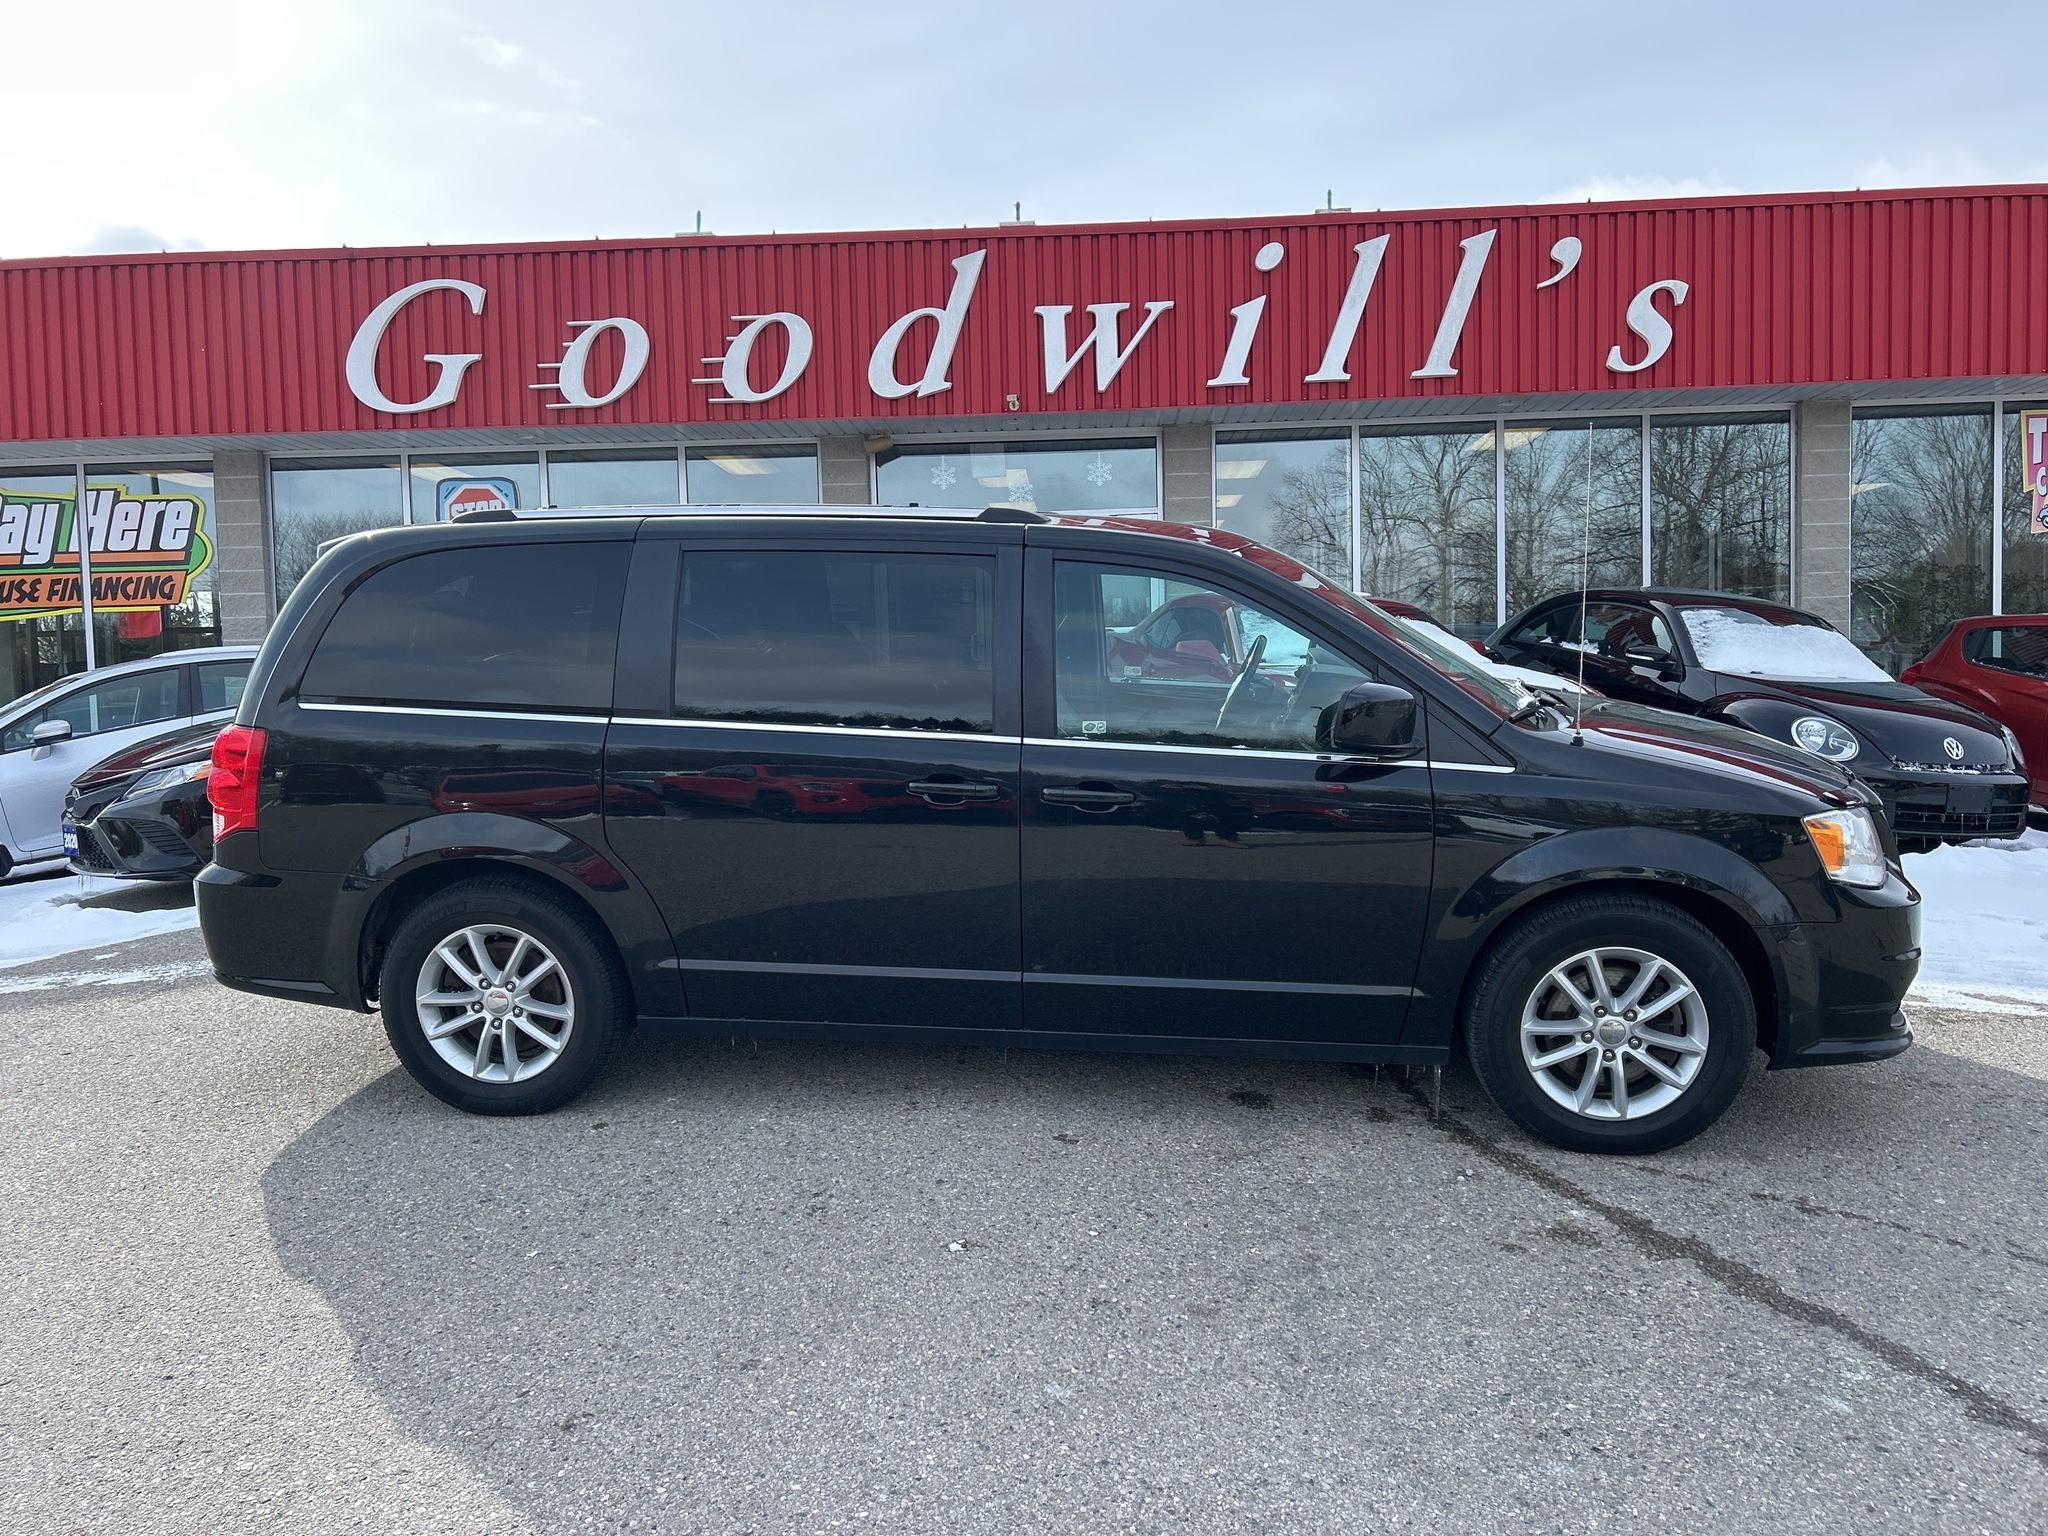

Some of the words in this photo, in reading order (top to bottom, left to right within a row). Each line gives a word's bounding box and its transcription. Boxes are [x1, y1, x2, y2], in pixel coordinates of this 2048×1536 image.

[346, 228, 1690, 414] Goodwill's
[0, 495, 59, 565] ay
[69, 490, 194, 551] Here
[46, 574, 177, 602] FINANCING
